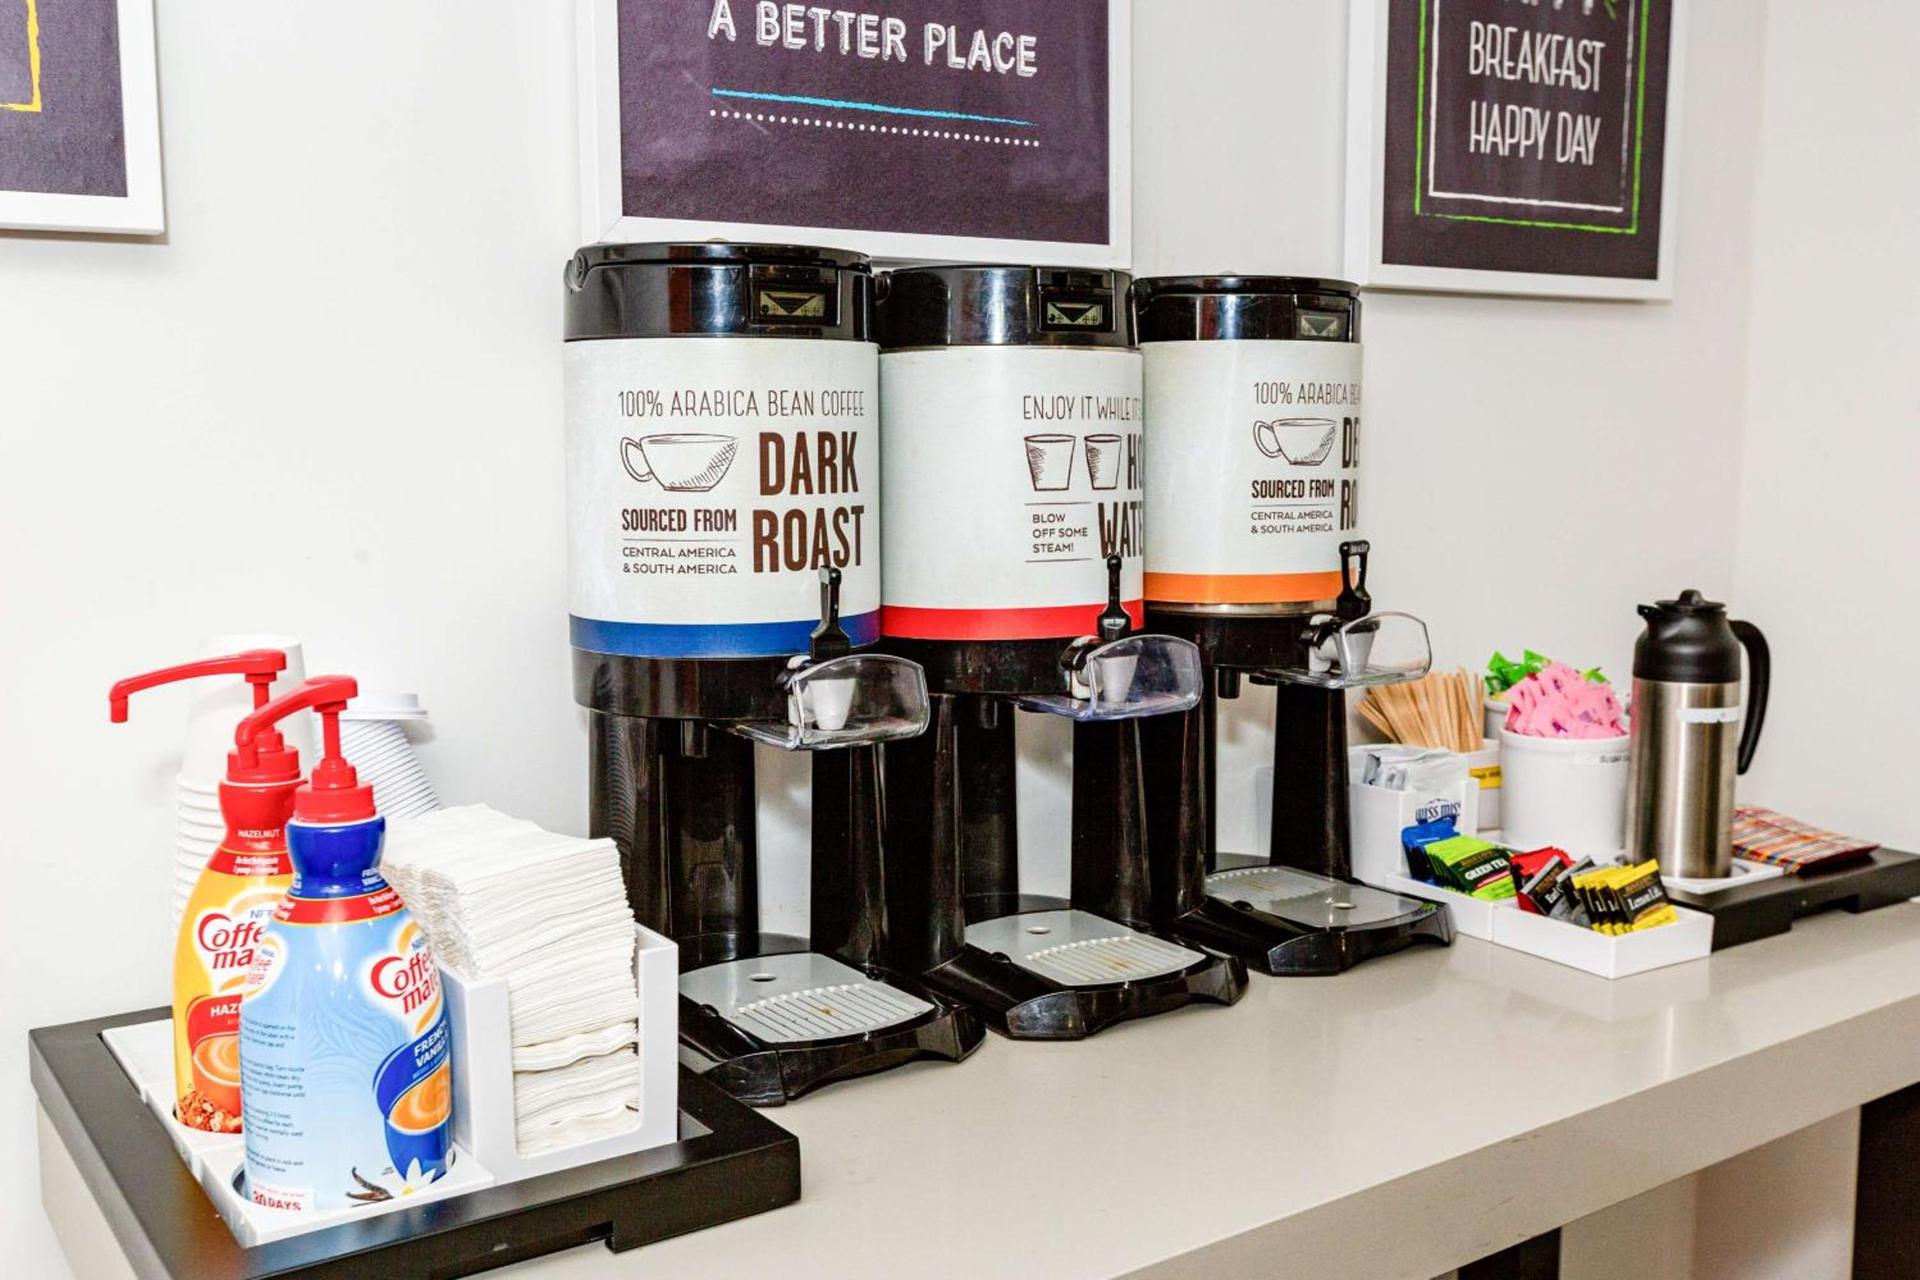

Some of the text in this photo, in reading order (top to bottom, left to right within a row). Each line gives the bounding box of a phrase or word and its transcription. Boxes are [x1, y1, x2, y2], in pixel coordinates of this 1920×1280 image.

[708, 0, 1038, 77] A BETTER PLACE
[1469, 21, 1606, 92] BREAKFAST
[1469, 100, 1601, 165] HAPPY DAY
[618, 390, 865, 417] 100% ARABICA BEAN COFFEE
[1254, 382, 1292, 405] 100%
[1297, 383, 1347, 405] ARABICA
[1023, 395, 1075, 420] ENJOY
[1081, 396, 1092, 420] IT
[1096, 396, 1131, 421] WHILE
[758, 431, 859, 496] DARK
[1251, 479, 1334, 499] SOURCED FROM
[621, 508, 737, 532] SOURCED FROM
[1032, 513, 1066, 524] BLOW
[1251, 510, 1333, 521] CENTRAL AMERICA
[752, 505, 864, 573] ROAST
[1032, 527, 1088, 539] OFF SOME
[1251, 524, 1333, 534] & SOUTH AMERICA
[622, 547, 736, 558] CENTRAL AMERICA
[1033, 543, 1074, 554] STEAM!
[622, 563, 737, 574] & SOUTH AMERICA
[238, 829, 280, 838] HAZELNUT
